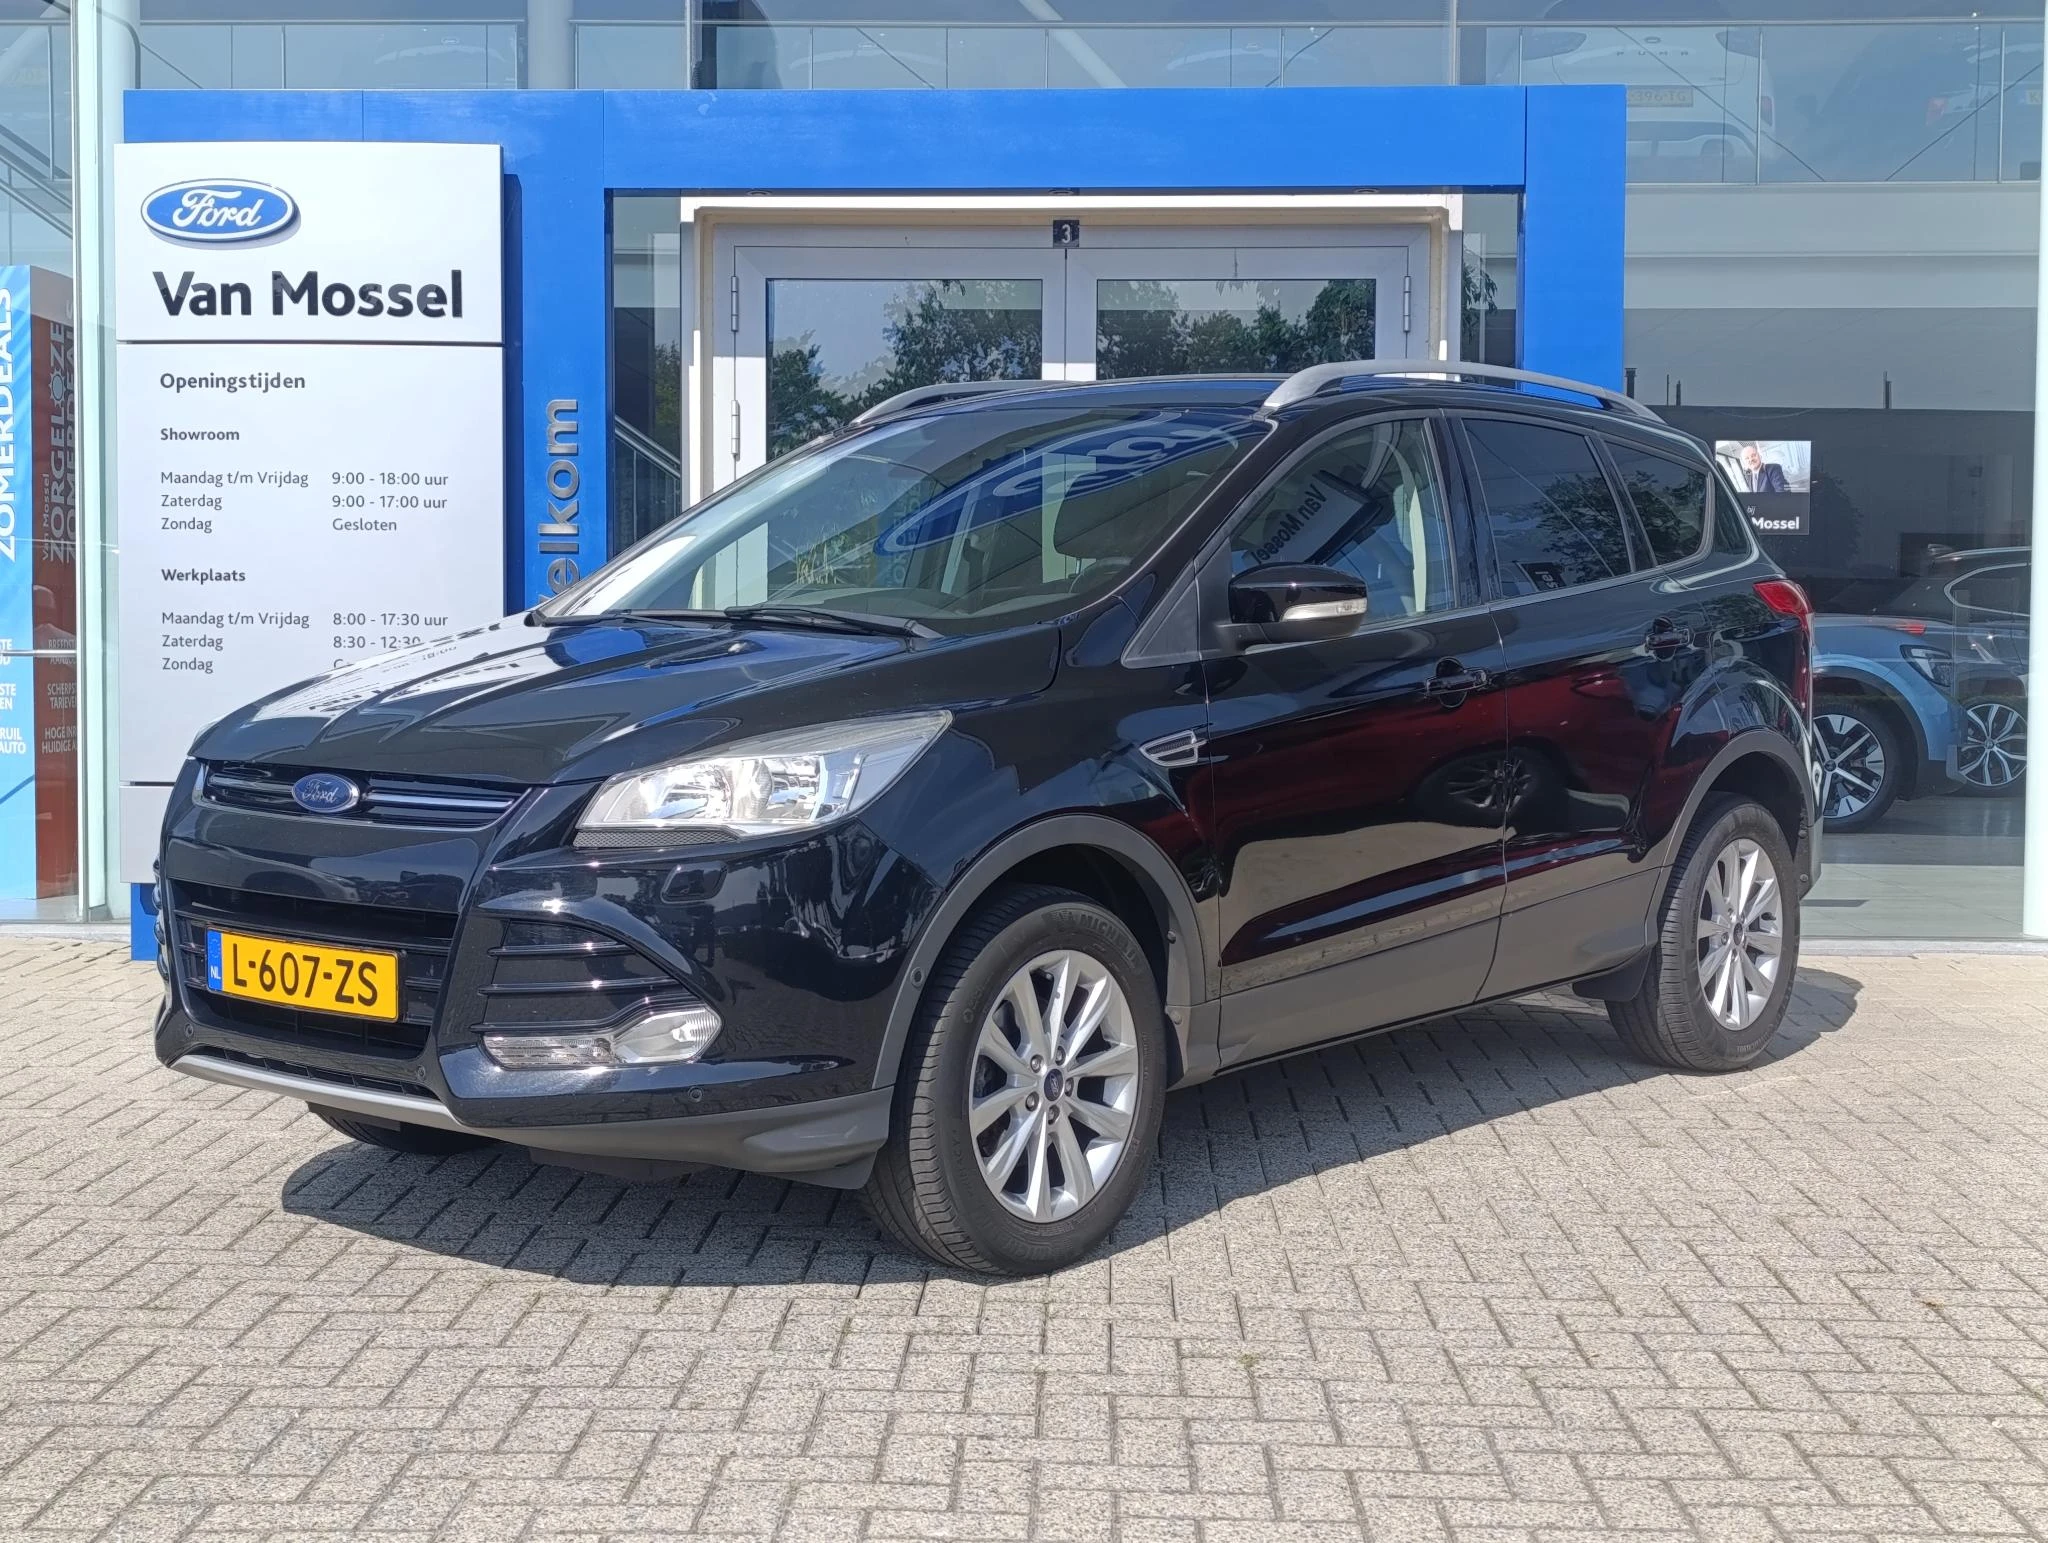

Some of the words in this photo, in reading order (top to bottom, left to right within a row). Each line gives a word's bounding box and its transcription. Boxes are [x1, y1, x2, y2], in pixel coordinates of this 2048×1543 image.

[171, 188, 265, 228] Ford
[1062, 224, 1071, 243] 3
[153, 271, 251, 316] Van
[271, 269, 463, 319] Mossel
[160, 372, 306, 393] Openingstijden
[160, 427, 240, 441] Showroom
[161, 471, 223, 487] Maandag
[227, 470, 253, 485] t/m
[257, 471, 309, 487] Vrijdag
[332, 472, 365, 485] 9:00
[379, 472, 420, 485] 18:00
[424, 474, 449, 485] uur
[161, 494, 222, 510] Zaterdag
[332, 495, 365, 508] 9:00
[379, 495, 419, 508] 17:00
[423, 498, 448, 508] uur
[538, 398, 580, 602] elkom
[161, 517, 212, 533] Zondag
[332, 517, 397, 531] Gesloten
[1751, 516, 1800, 530] Mossel
[161, 568, 246, 584] Werkplaats
[162, 612, 224, 628] Maandag
[228, 611, 254, 626] t/m
[258, 612, 309, 628] Vrijdag
[333, 613, 366, 626] 8:00
[380, 613, 420, 626] 17:30
[424, 616, 449, 626] uur
[162, 634, 223, 650] Zaterdag
[333, 635, 366, 648] 8:30
[162, 657, 213, 674] Zondag
[302, 779, 340, 803] Ford
[210, 965, 221, 980] NL
[233, 943, 378, 1007] L-607-ZS
